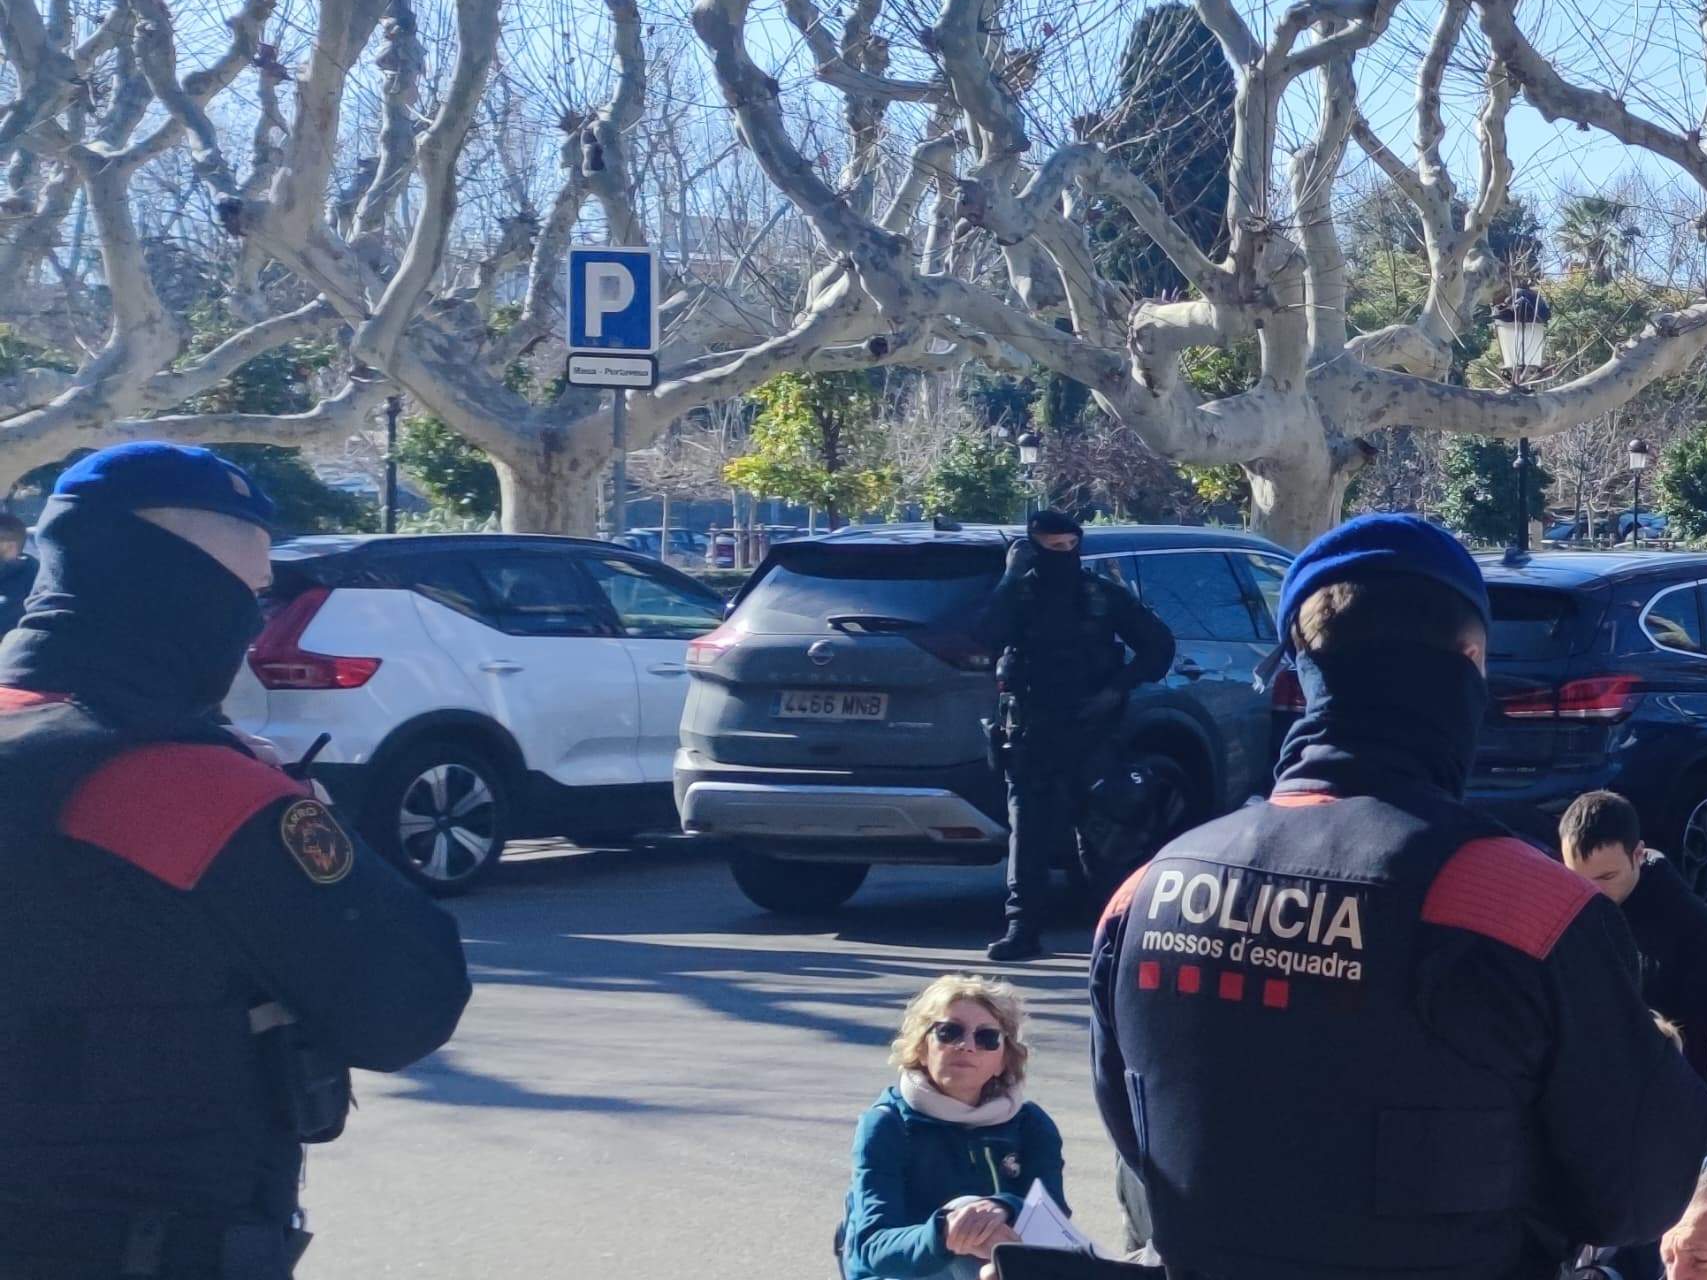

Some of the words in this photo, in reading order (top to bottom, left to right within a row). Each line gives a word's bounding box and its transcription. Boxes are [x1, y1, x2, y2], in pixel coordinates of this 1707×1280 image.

[585, 262, 635, 337] P
[1142, 930, 1224, 959] mossos
[1147, 869, 1364, 950] POLICIA
